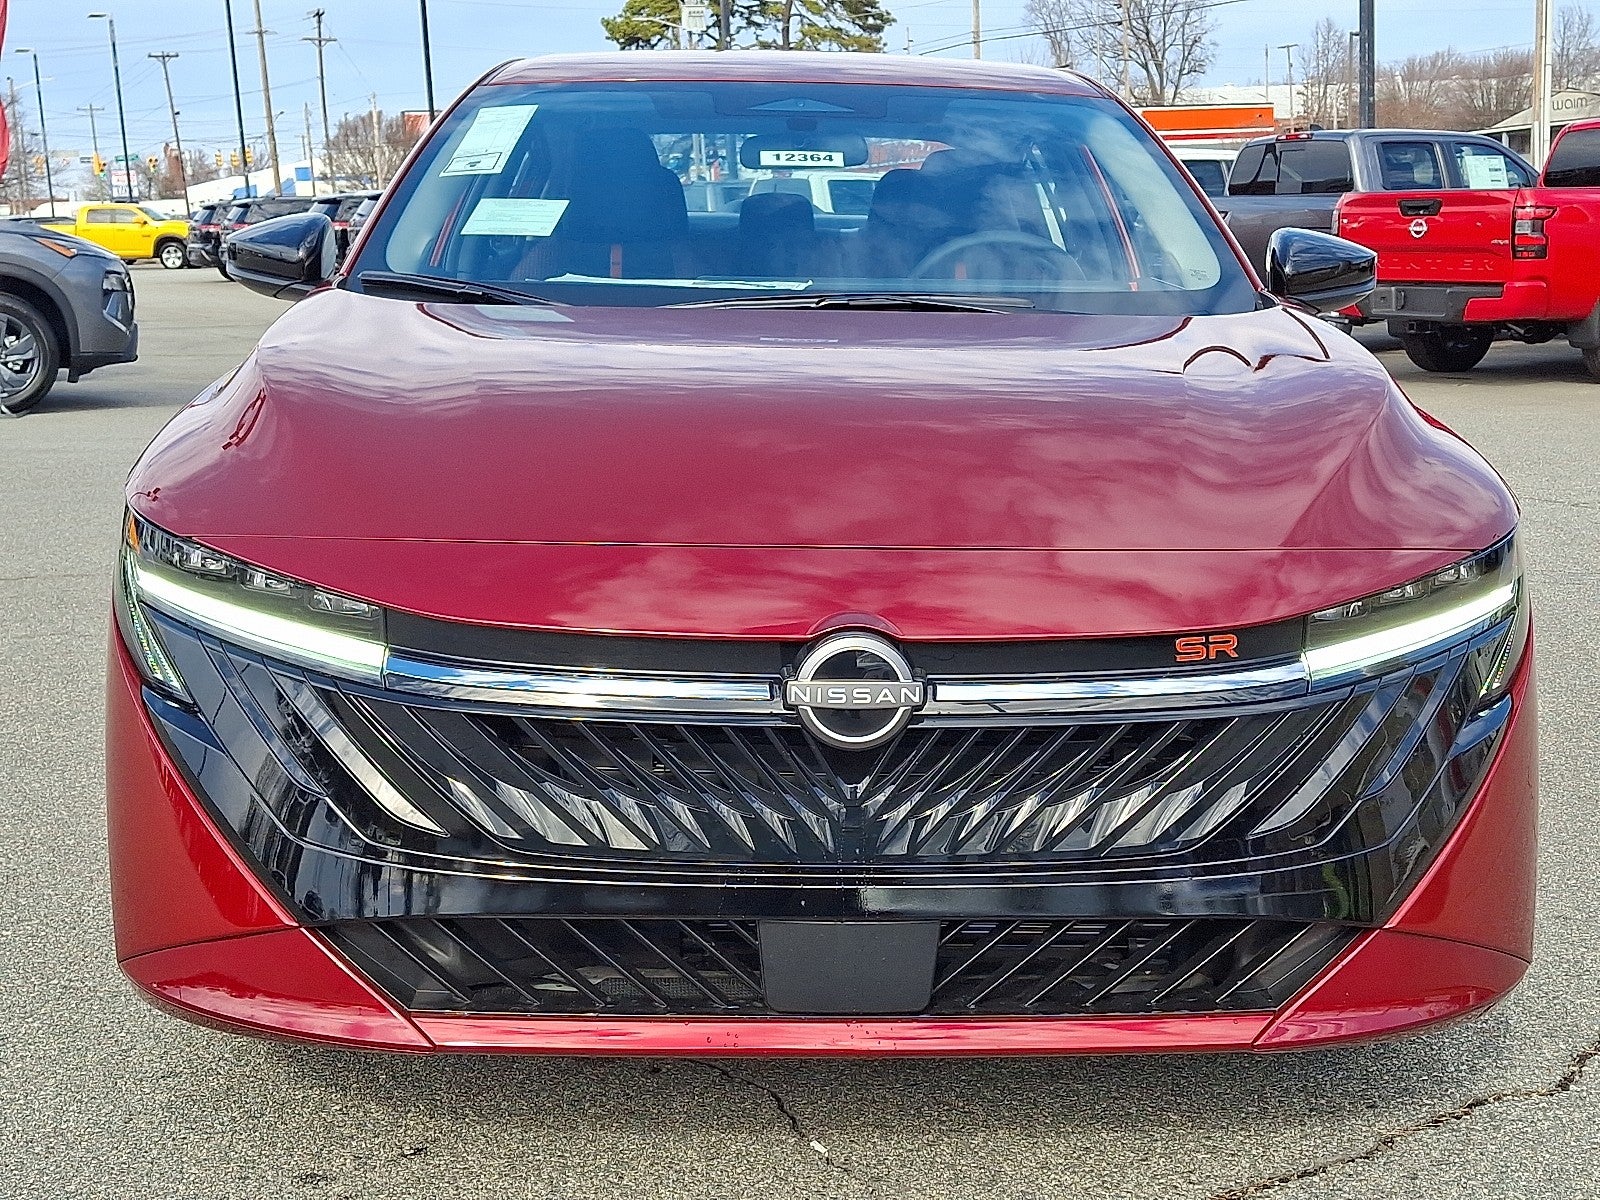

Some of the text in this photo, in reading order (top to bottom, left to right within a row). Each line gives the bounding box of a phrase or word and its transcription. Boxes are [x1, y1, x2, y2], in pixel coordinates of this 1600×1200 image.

[772, 153, 834, 162] 12364
[1175, 633, 1239, 662] SR
[790, 685, 920, 704] NISSAN
